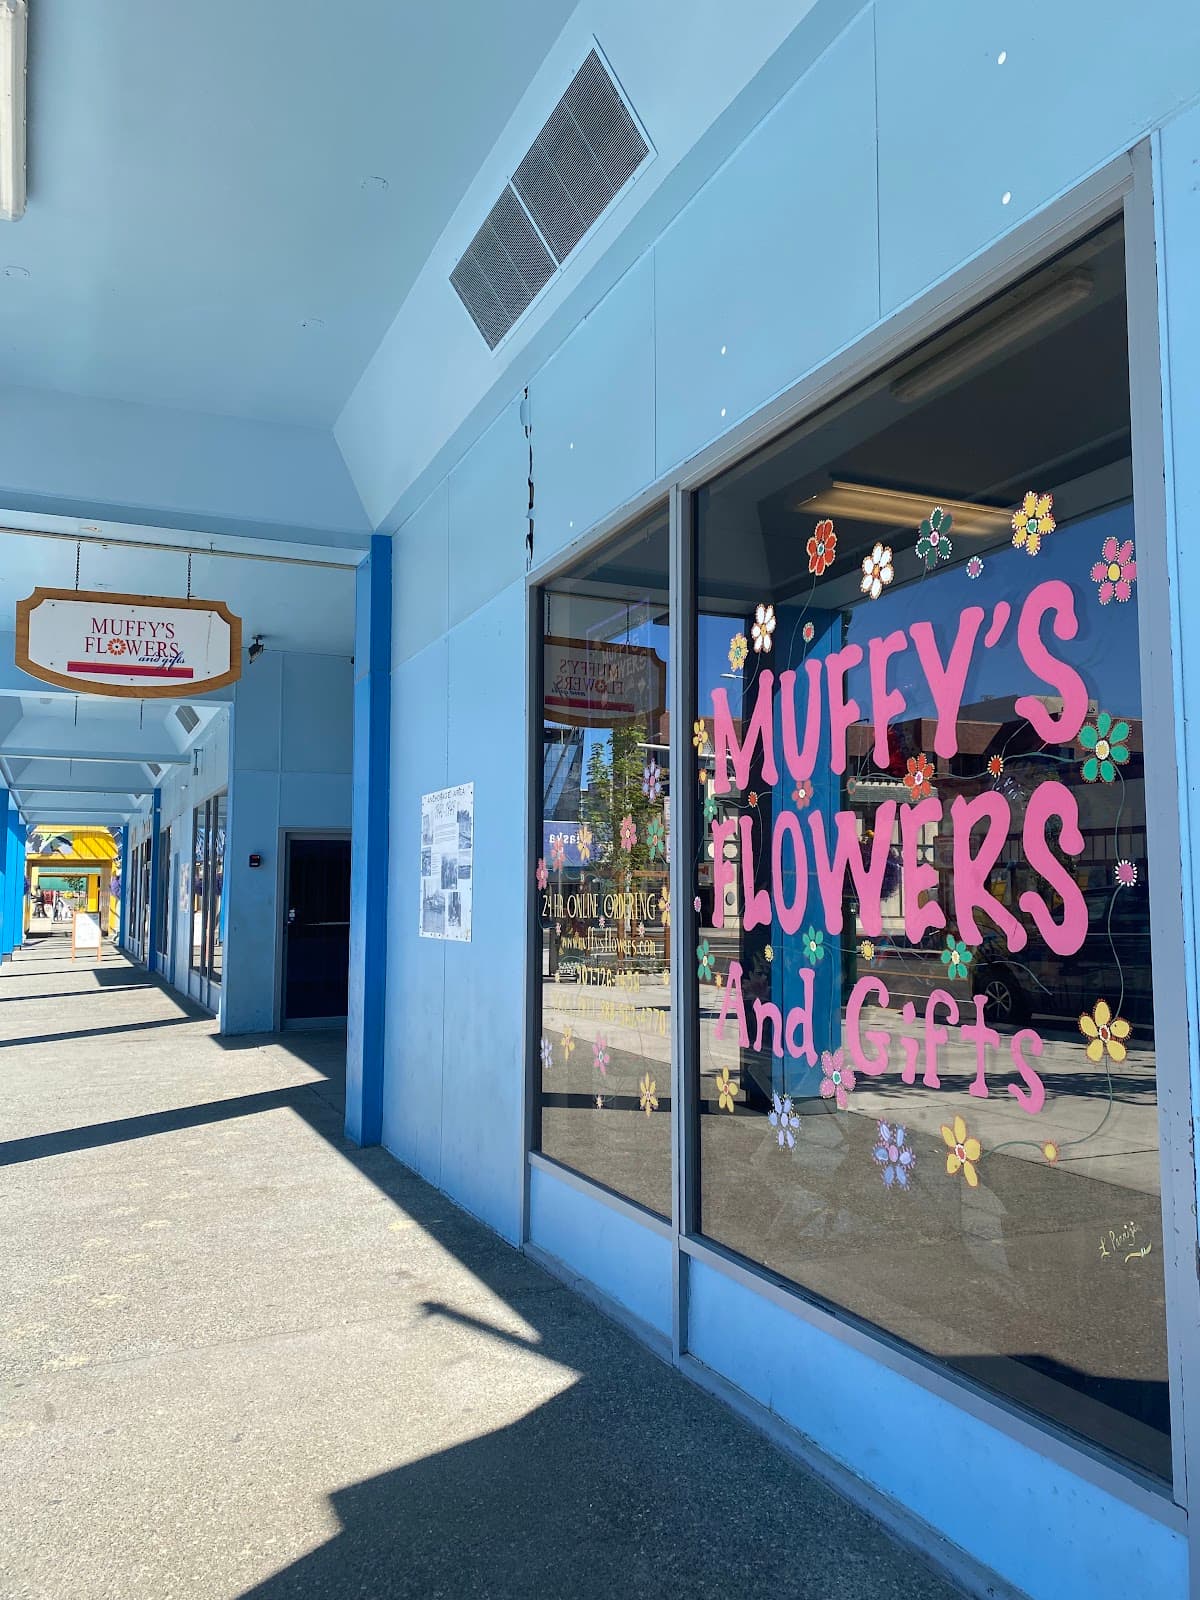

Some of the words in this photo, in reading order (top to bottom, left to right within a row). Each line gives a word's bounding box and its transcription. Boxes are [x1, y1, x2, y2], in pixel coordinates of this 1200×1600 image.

[91, 617, 175, 639] MUFFY'S
[84, 636, 180, 658] FLOWERS
[138, 650, 160, 663] and
[711, 581, 1088, 793] MUFFY'S
[711, 781, 1088, 955] FLOWERS
[567, 893, 599, 919] ONLINE
[603, 892, 656, 920] ORDERING
[715, 962, 817, 1068] And
[847, 977, 1045, 1114] Gifts
